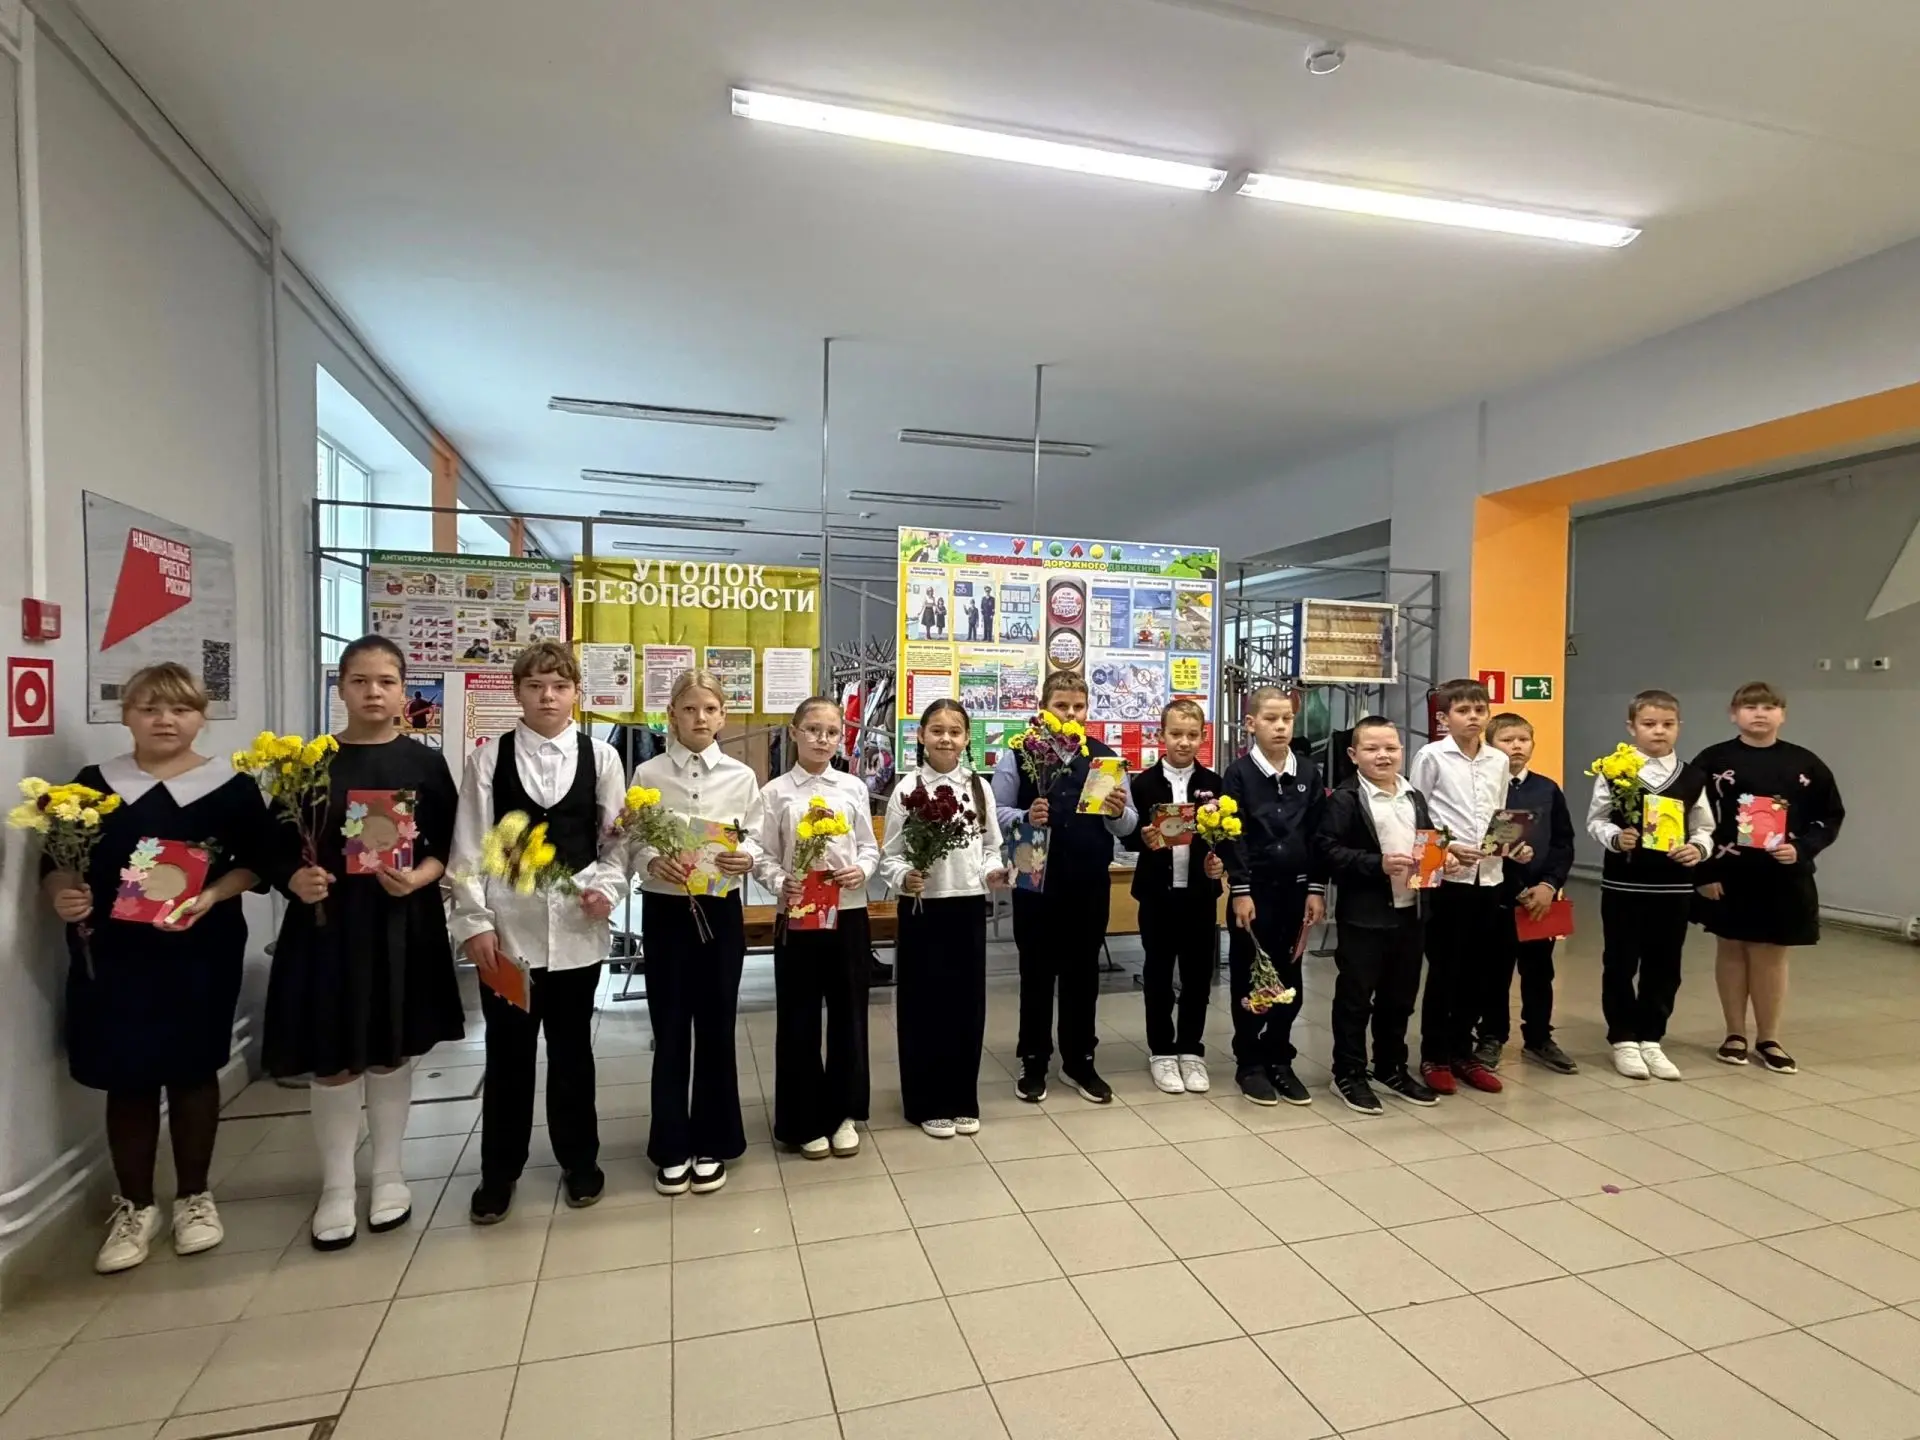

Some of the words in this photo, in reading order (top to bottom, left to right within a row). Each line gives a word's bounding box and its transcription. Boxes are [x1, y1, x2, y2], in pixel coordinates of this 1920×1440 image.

[132, 530, 191, 564] НАЦИОНАЛЬНЫЕ
[1011, 537, 1124, 561] УГОЛОК
[159, 556, 190, 581] ПРОЕКТЫ
[380, 553, 487, 567] АНТИТЕРРОРИСТИЧЕСКАЯ
[488, 558, 552, 570] БЕЗОПАСНОСТЬ
[632, 558, 766, 588] УГОЛОК
[966, 553, 1043, 567] БЕЗОПАСНОСТИ
[1043, 559, 1107, 572] ДОРОЖНОГО
[1107, 562, 1161, 574] ДВИЖЕНИЯ
[165, 576, 190, 598] РОССИИ
